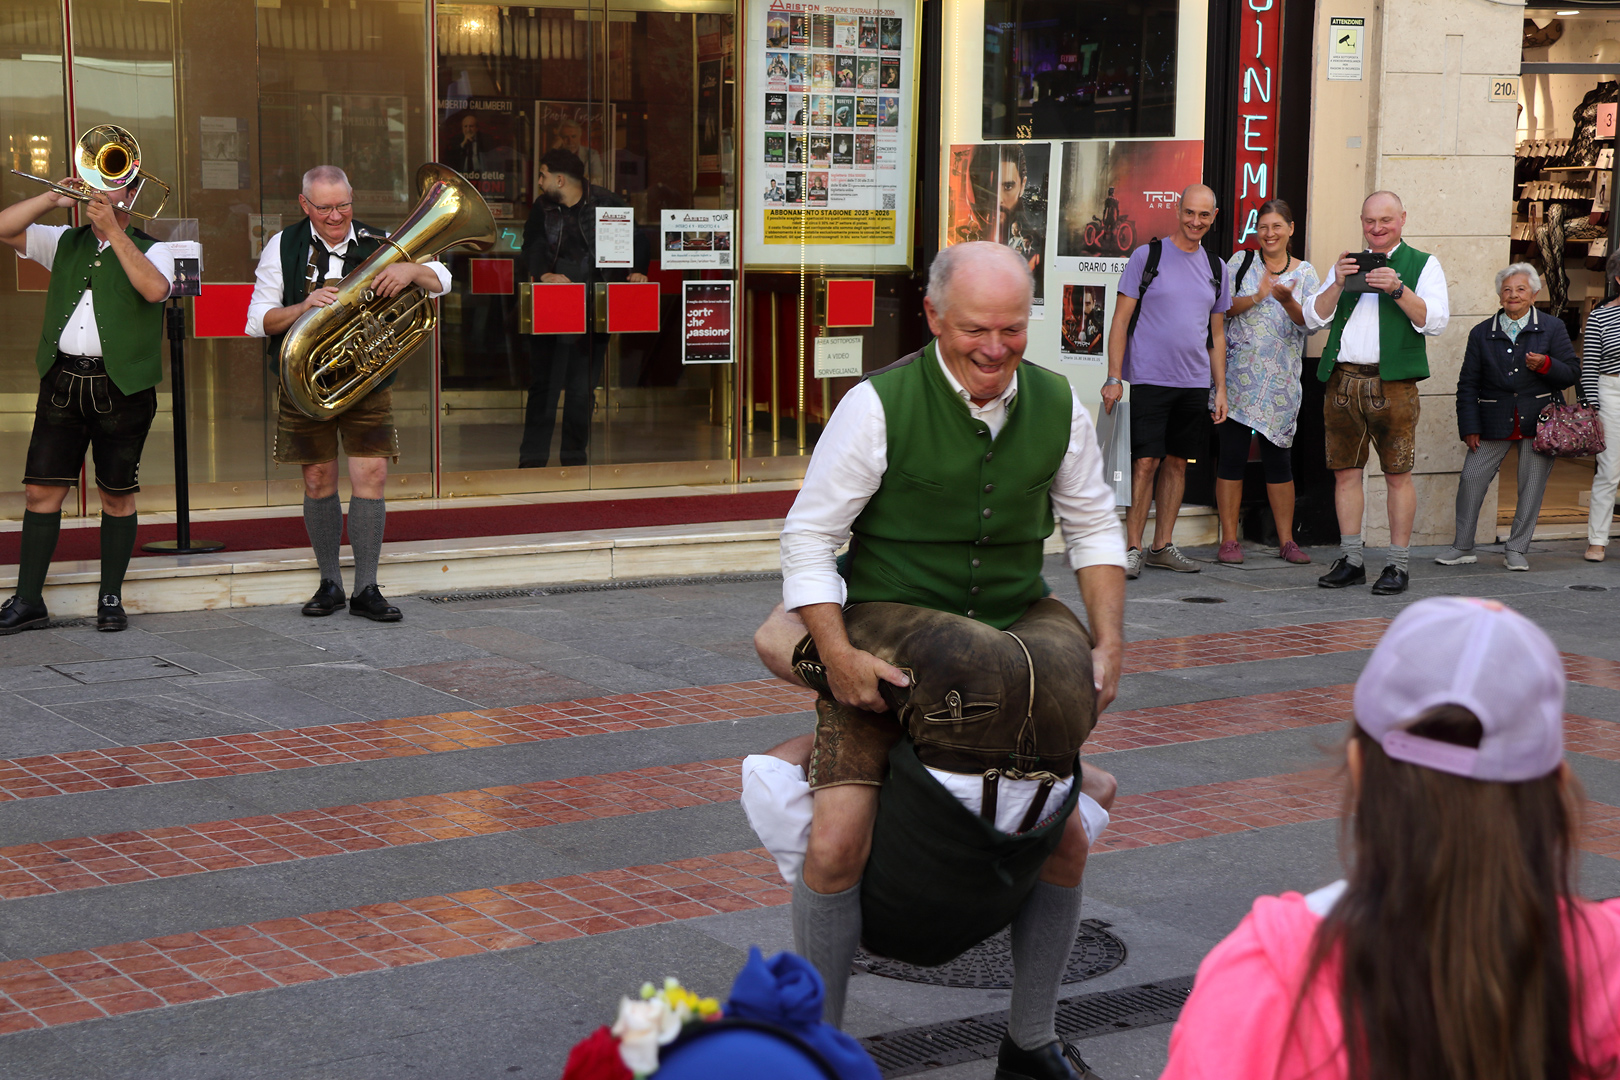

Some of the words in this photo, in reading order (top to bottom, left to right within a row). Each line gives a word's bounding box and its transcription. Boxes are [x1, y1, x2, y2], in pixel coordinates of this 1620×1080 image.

[769, 0, 820, 12] ARISTON
[1494, 82, 1512, 96] 210
[438, 100, 468, 110] MBERTO
[1238, 0, 1273, 243] INEMA
[460, 171, 480, 180] ndo
[481, 171, 505, 180] delle
[1143, 191, 1182, 202] TRON
[1078, 262, 1107, 272] ORARIO
[687, 308, 714, 317] corte
[687, 317, 705, 327] che
[686, 327, 730, 339] passione
